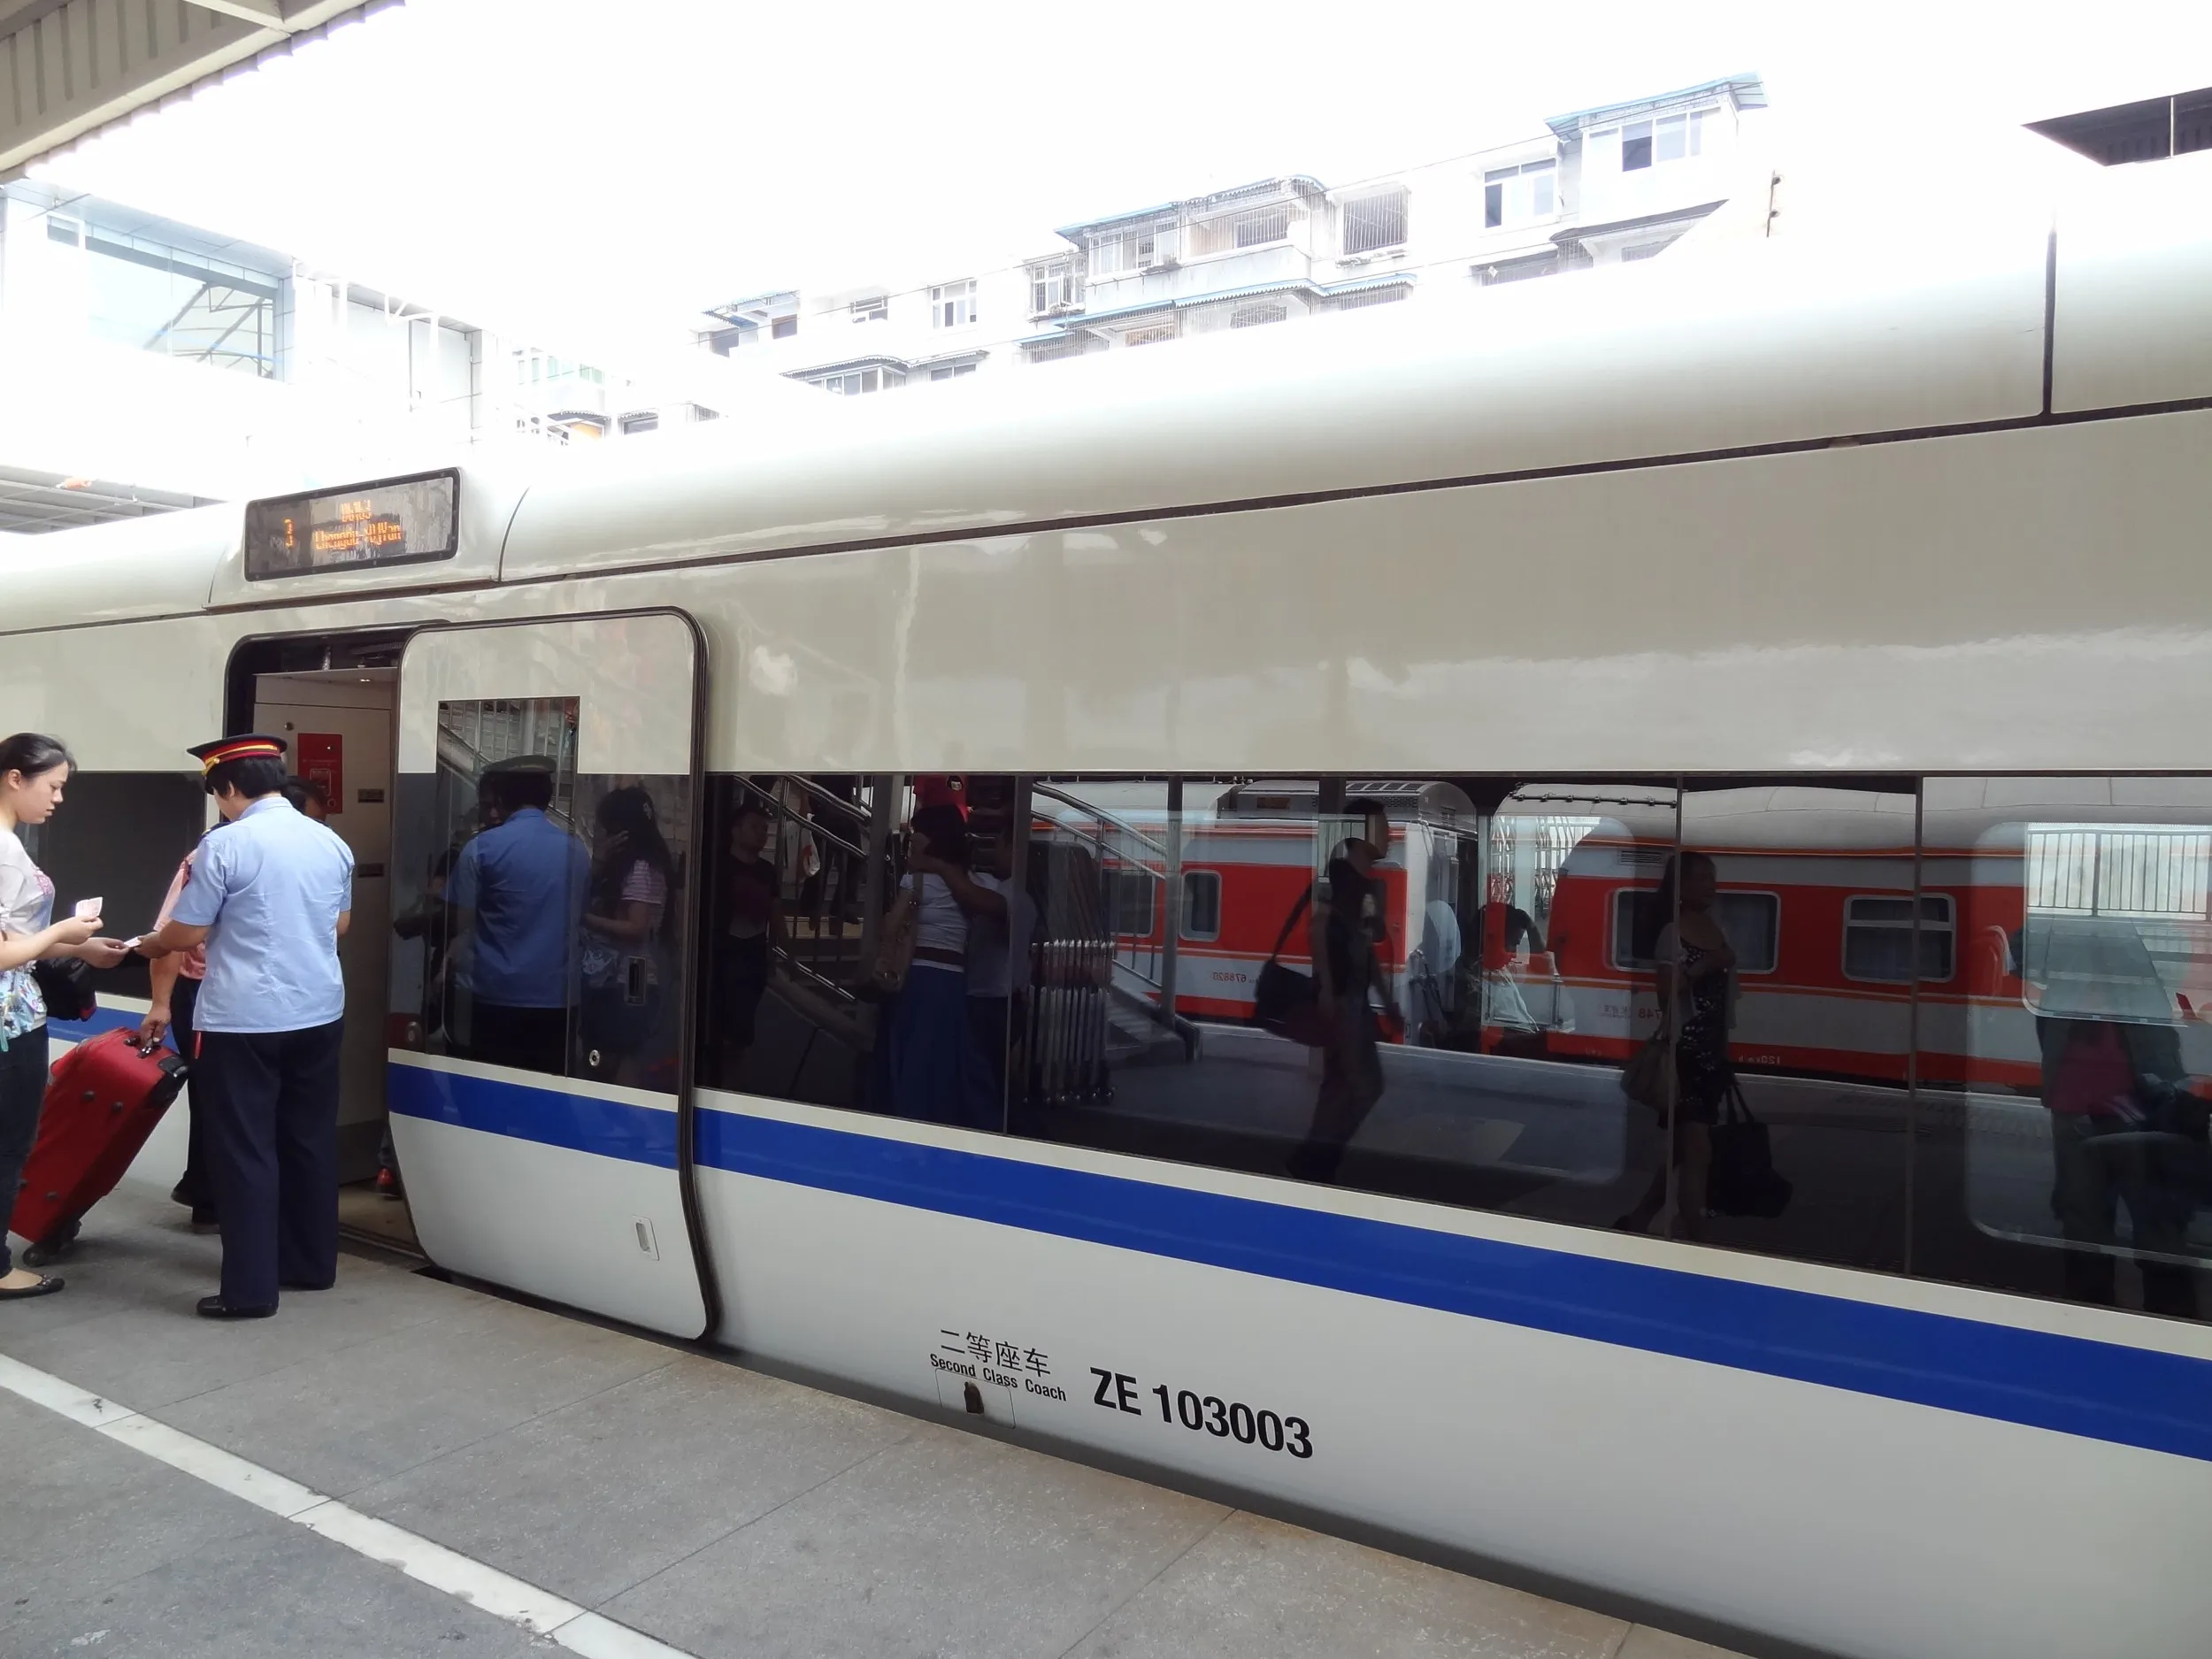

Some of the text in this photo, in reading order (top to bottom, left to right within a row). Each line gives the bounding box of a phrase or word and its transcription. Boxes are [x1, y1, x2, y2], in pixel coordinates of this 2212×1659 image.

[929, 1353, 1067, 1402] Second Class Coach
[940, 1328, 1052, 1378] 二等座车
[1089, 1366, 1314, 1460] ZE 103003
